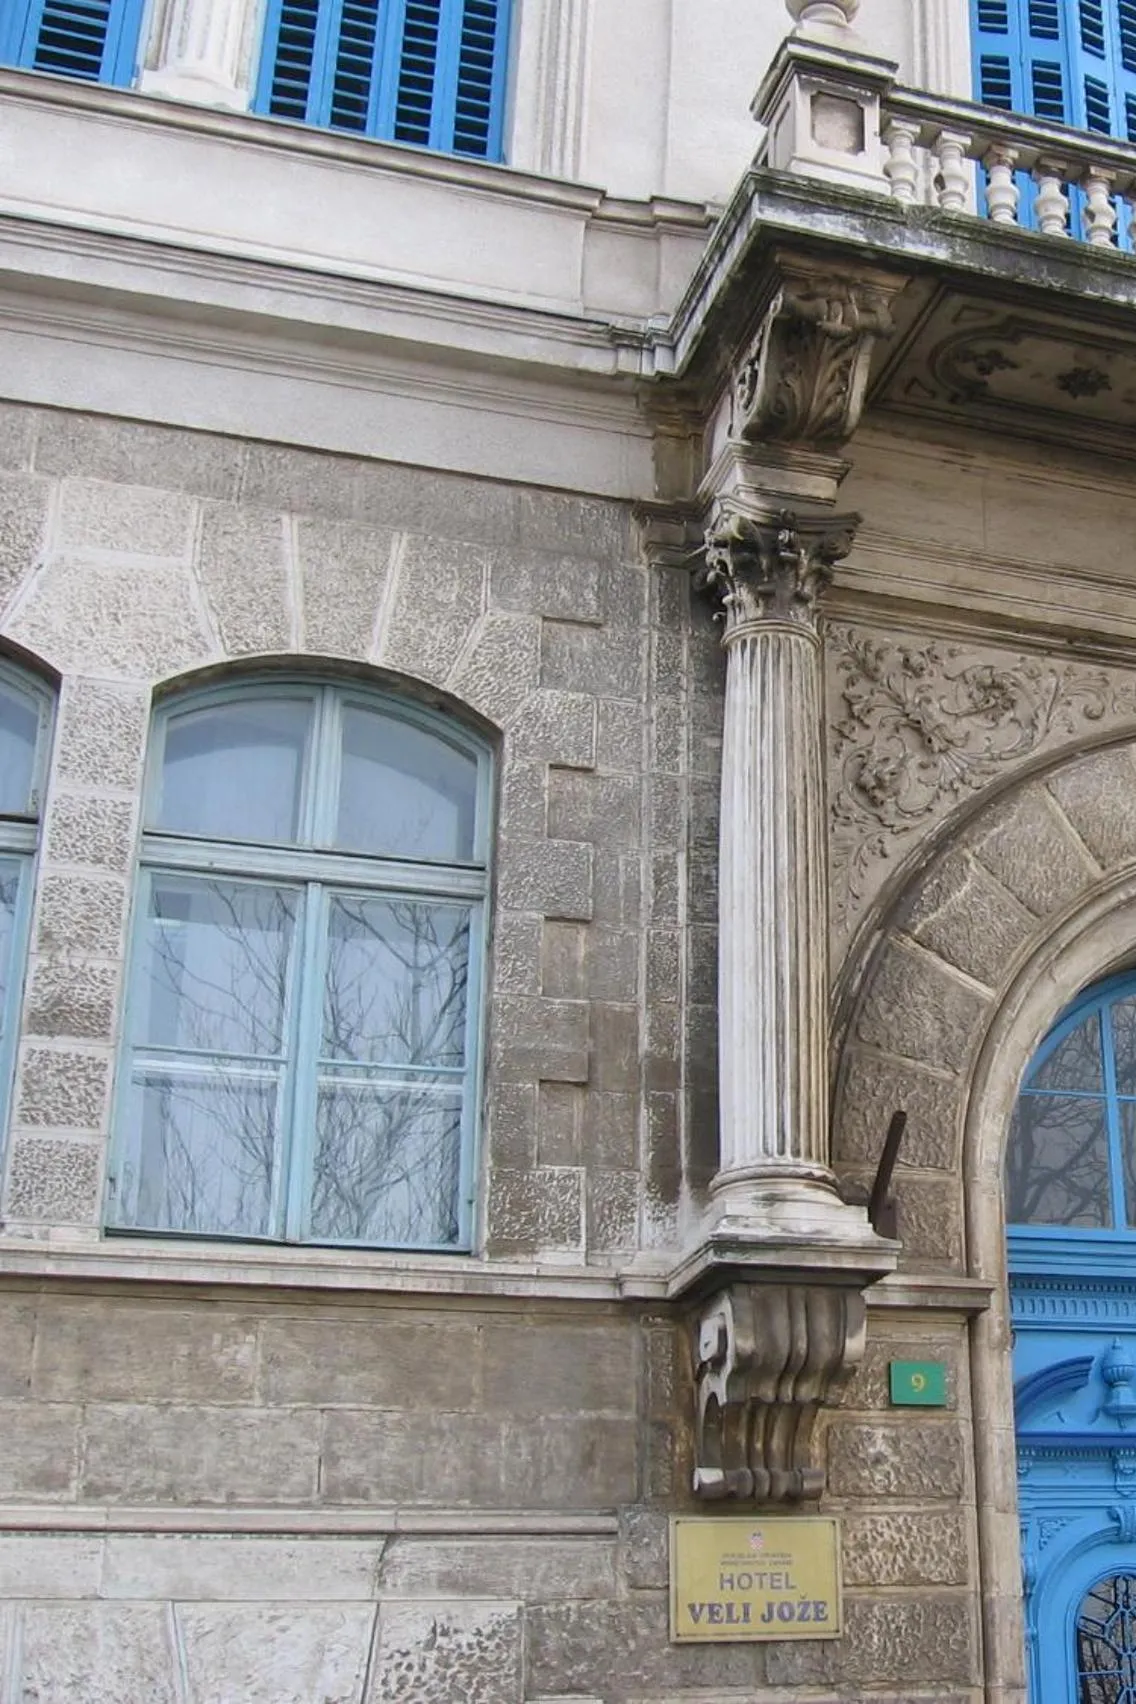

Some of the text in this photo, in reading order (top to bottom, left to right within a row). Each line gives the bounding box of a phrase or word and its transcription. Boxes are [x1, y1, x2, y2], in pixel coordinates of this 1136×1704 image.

[911, 1373, 925, 1393] 9
[719, 1572, 796, 1591] HOTEL
[688, 1593, 828, 1624] VELI JOŽE
